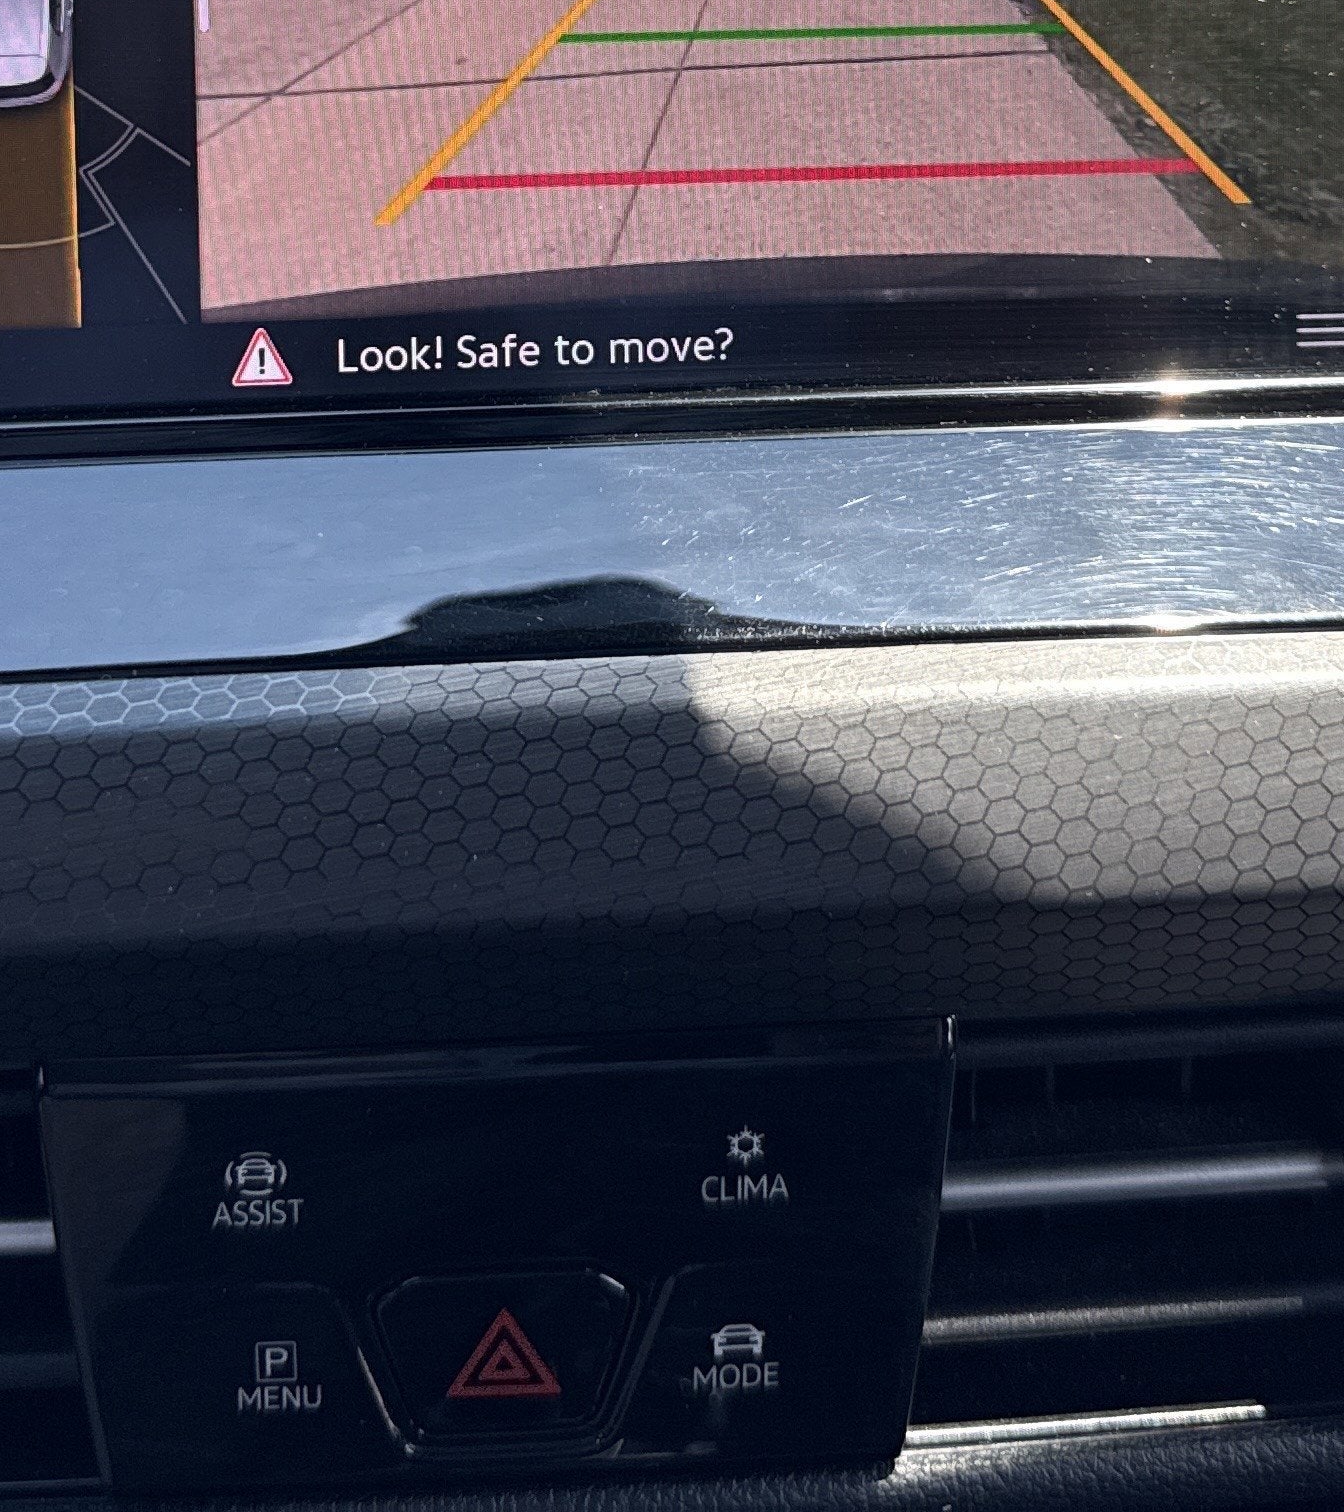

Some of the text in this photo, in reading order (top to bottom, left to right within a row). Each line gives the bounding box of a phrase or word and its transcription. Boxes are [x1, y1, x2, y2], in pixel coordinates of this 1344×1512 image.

[337, 326, 734, 373] Look! Safe to move?
[701, 1173, 790, 1203] CLIMA
[211, 1198, 305, 1229] ASSIST
[265, 1347, 289, 1377] P
[693, 1361, 780, 1391] MODE
[237, 1384, 322, 1410] MENU
